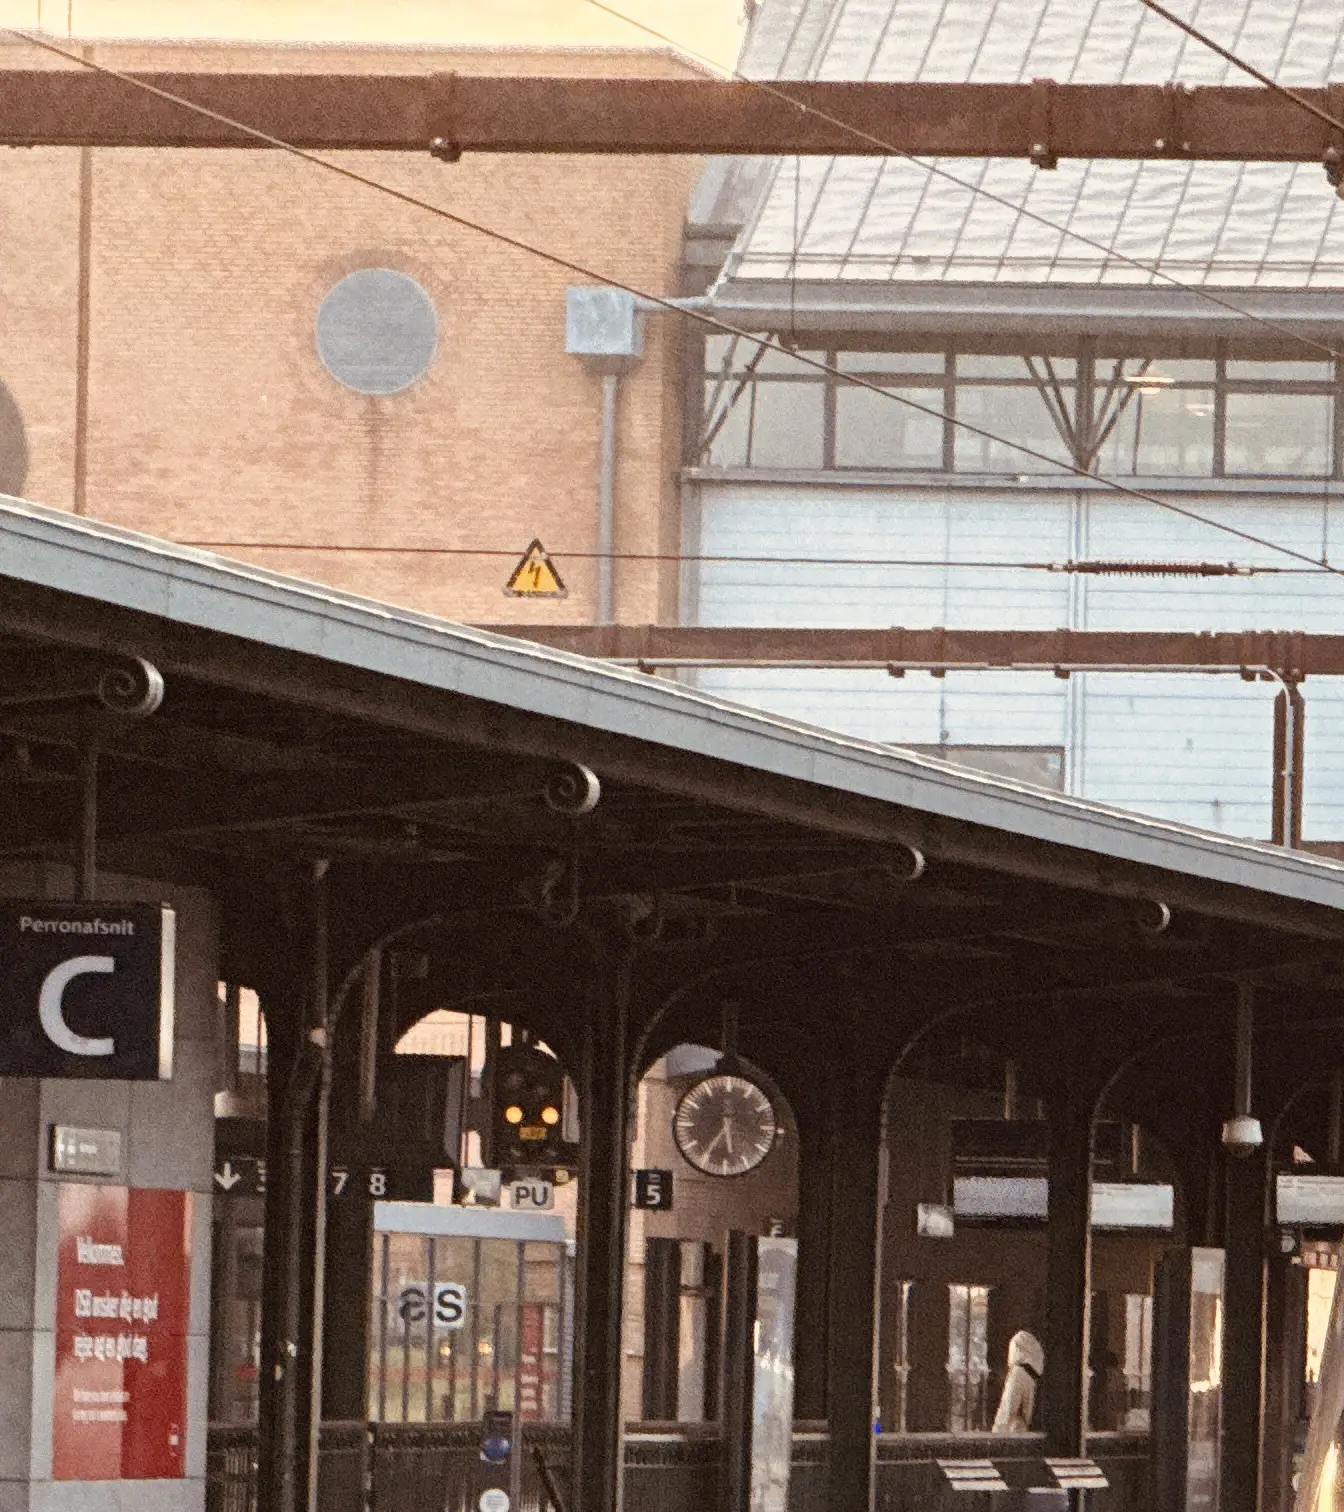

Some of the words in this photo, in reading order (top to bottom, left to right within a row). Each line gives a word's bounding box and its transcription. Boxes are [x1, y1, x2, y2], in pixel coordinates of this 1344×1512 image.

[19, 915, 134, 936] Perronafsnit
[39, 954, 115, 1056] C
[331, 1171, 349, 1195] 7
[369, 1173, 386, 1196] 8
[646, 1184, 661, 1205] 5
[515, 1185, 549, 1206] PU
[436, 1289, 463, 1322] S
